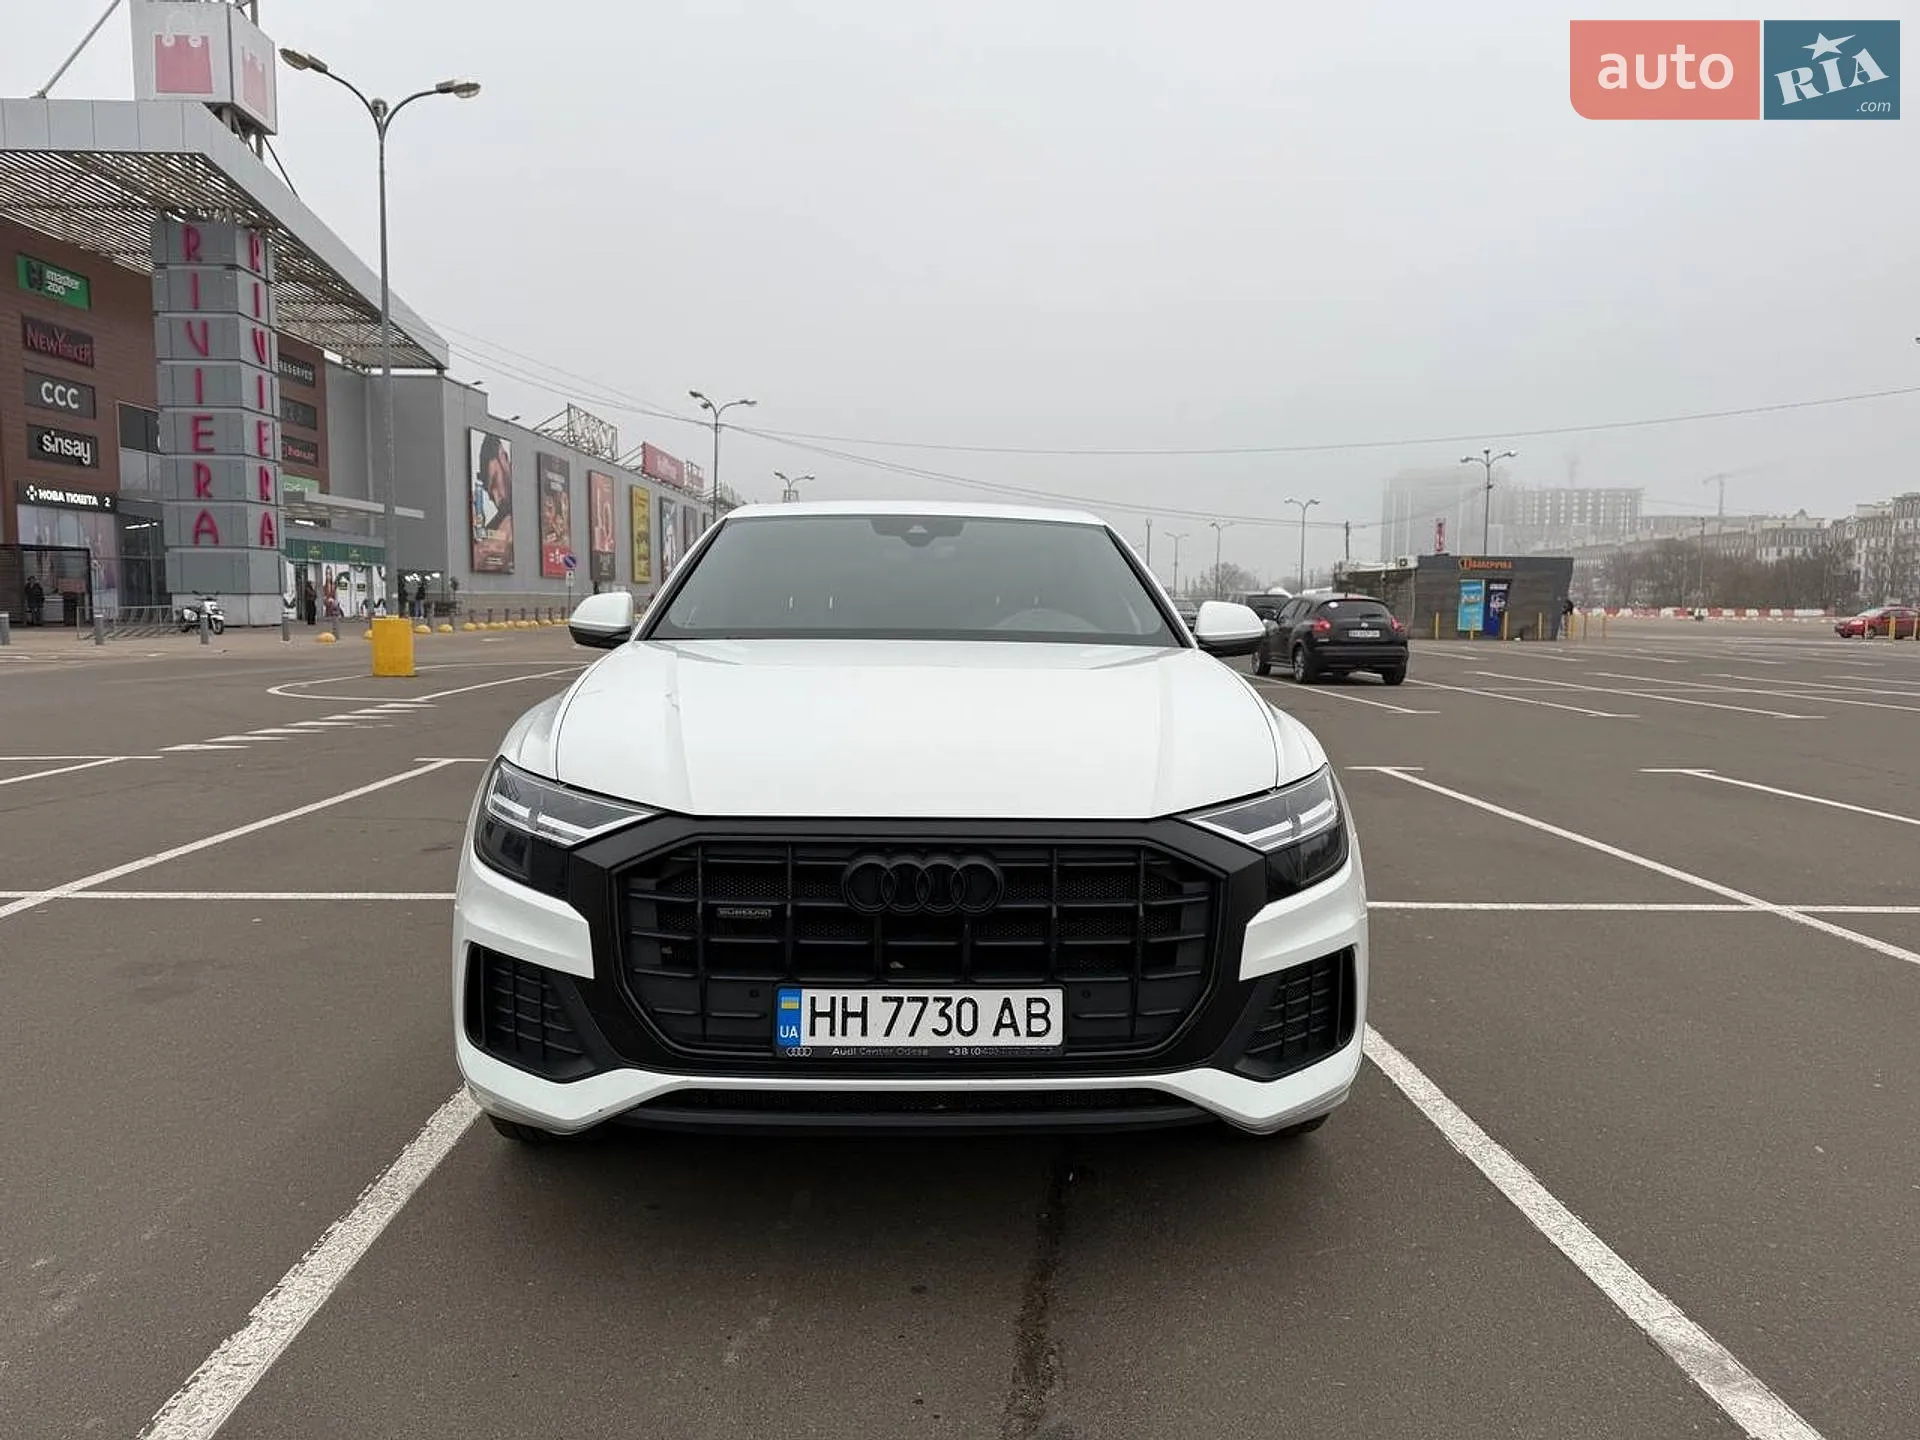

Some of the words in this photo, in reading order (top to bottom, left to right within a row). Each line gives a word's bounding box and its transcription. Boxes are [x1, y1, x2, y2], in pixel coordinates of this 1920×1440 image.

[41, 382, 79, 409] CCC
[181, 223, 220, 546] RIVIERA
[249, 232, 275, 547] RIVIERA
[42, 430, 91, 465] sinsay
[104, 497, 110, 507] 2
[780, 1026, 799, 1038] UA
[809, 996, 868, 1037] HH
[882, 996, 978, 1037] 7730
[993, 996, 1052, 1037] AB
[831, 1047, 857, 1056] Audi
